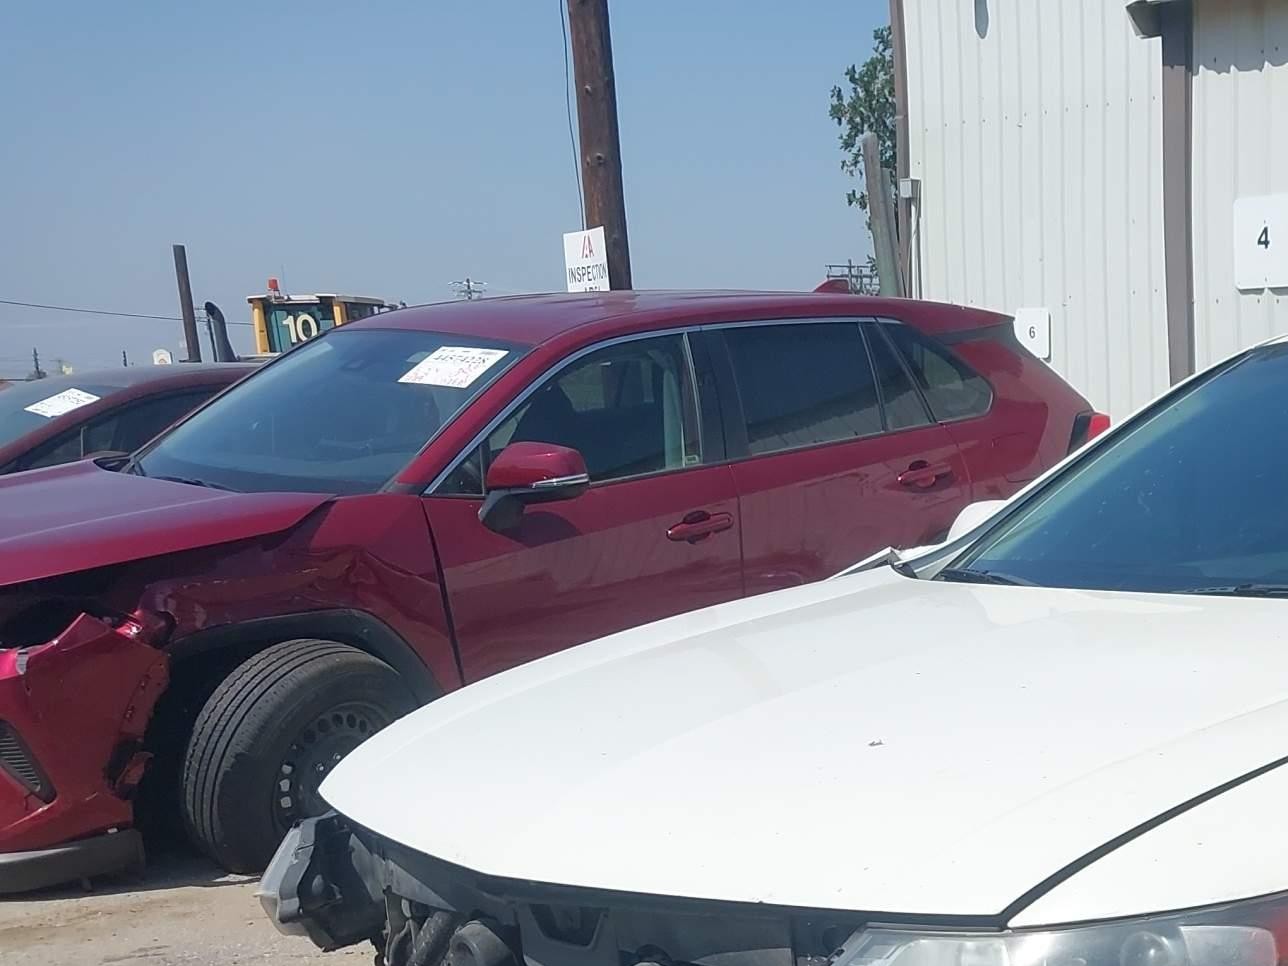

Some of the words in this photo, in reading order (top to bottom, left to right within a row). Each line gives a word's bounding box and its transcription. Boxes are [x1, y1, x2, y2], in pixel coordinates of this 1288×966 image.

[1257, 226, 1270, 249] 4
[567, 263, 608, 284] INSPECTION
[282, 313, 318, 344] 10
[1028, 325, 1036, 340] 6
